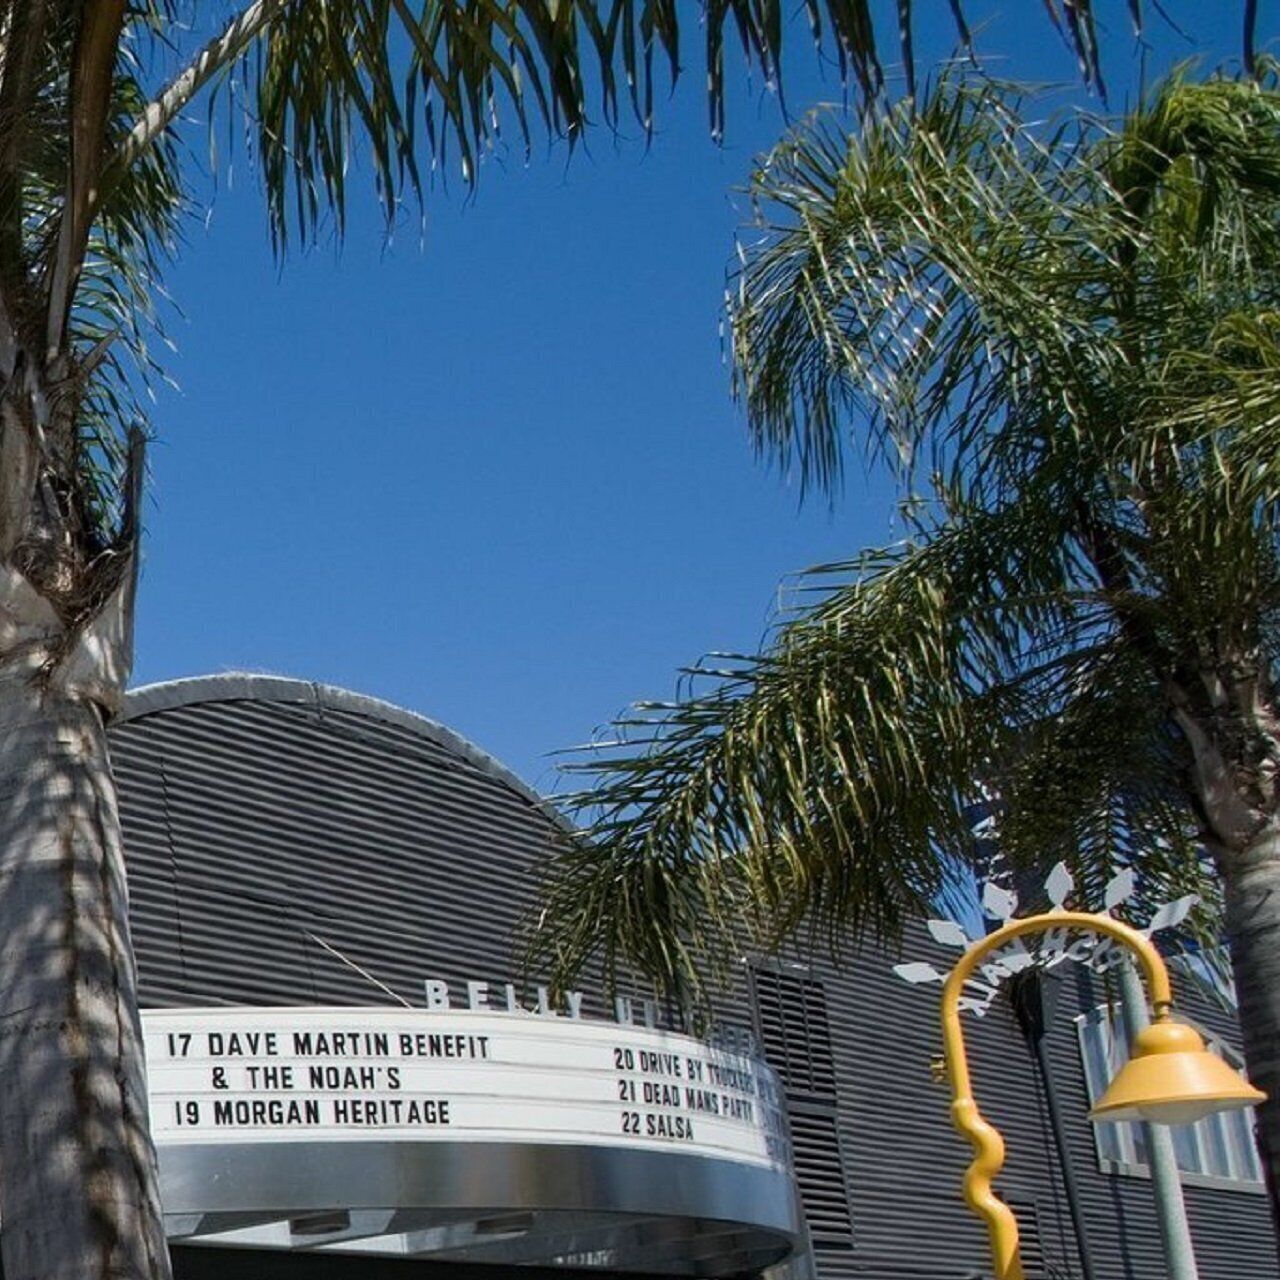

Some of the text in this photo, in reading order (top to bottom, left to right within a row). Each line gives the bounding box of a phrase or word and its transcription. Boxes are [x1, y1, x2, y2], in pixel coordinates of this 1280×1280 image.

[424, 979, 583, 1020] BELLY
[167, 1033, 490, 1059] 17 DAVE MARTIN BENEFIT
[211, 1066, 401, 1091] & THE NOAH'S
[613, 1047, 634, 1071] 20
[639, 1050, 682, 1077] DRIVE
[687, 1058, 703, 1082] BY
[618, 1079, 636, 1102] 21
[643, 1081, 681, 1108] DEAD
[685, 1087, 720, 1115] MANS
[173, 1100, 451, 1127] 19 MORGAN HERITAGE
[621, 1111, 695, 1141] 22 SALSA
